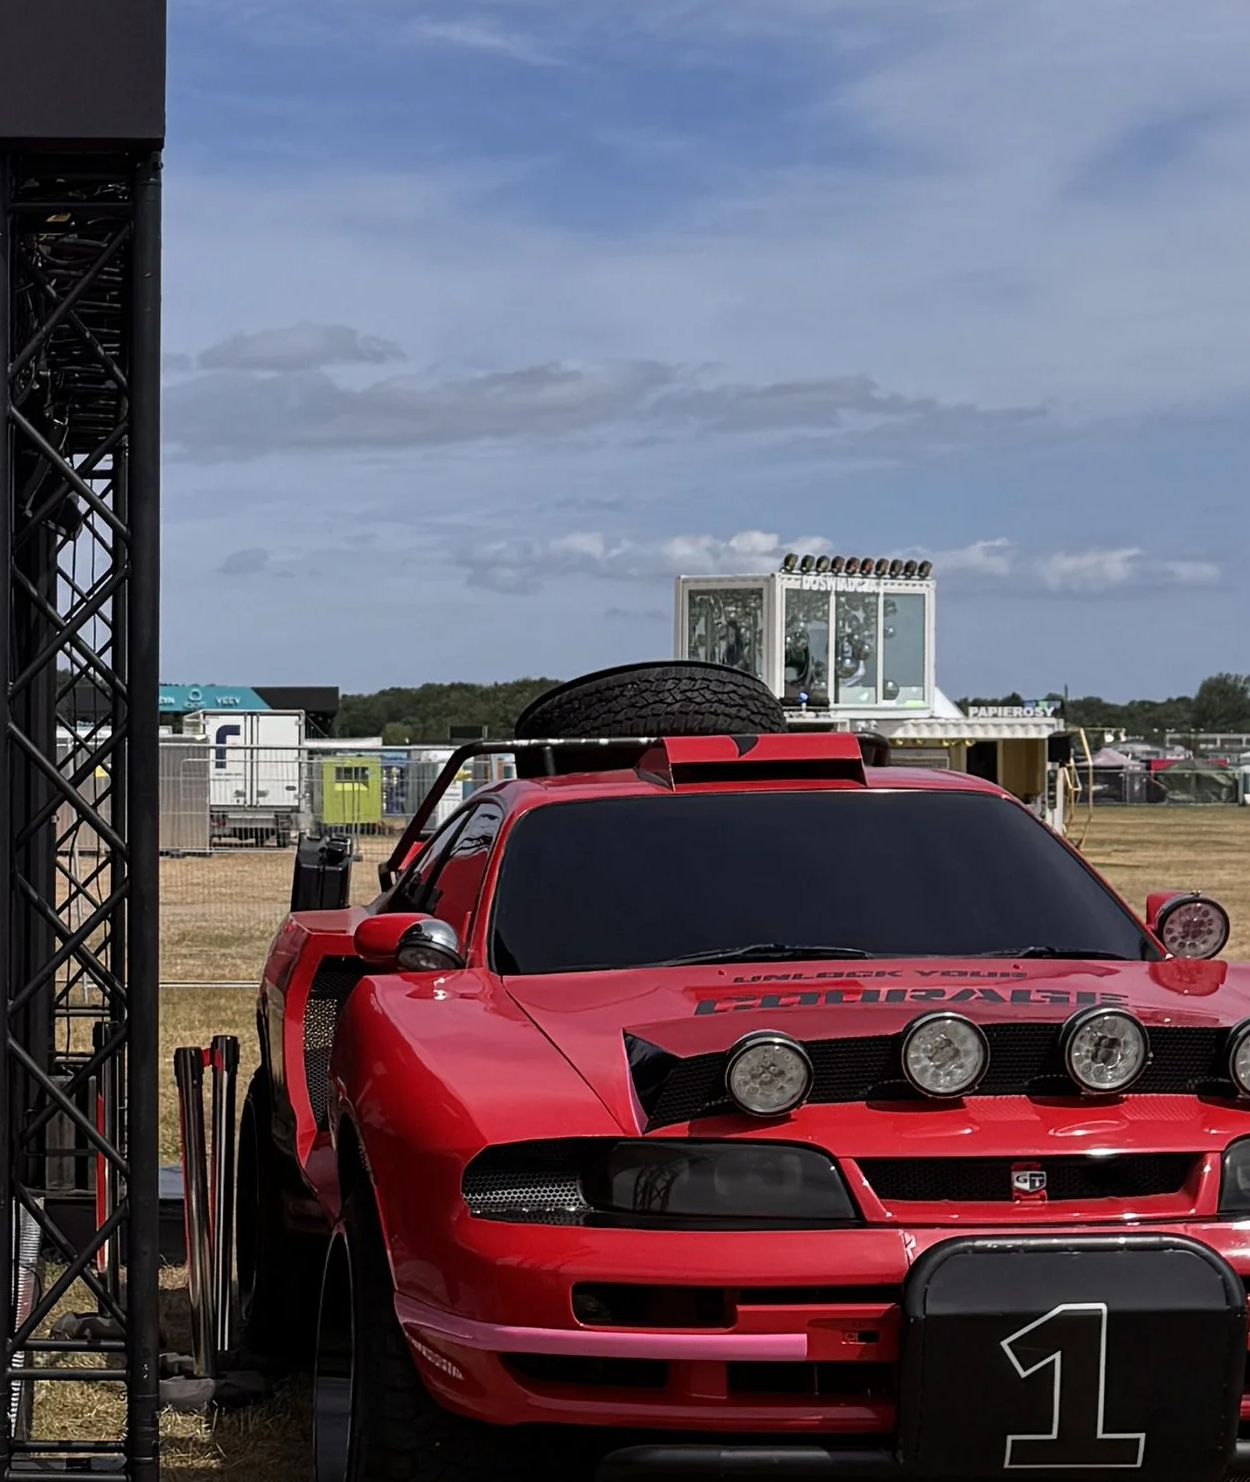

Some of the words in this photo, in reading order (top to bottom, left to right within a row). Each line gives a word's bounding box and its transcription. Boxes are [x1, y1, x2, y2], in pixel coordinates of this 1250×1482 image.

[969, 706, 1054, 717] PAPIEROSY
[733, 970, 903, 984] UNLOCK
[915, 970, 1028, 979] YOUR
[695, 987, 1129, 1017] COURAGE
[1000, 1302, 1146, 1469] 1
